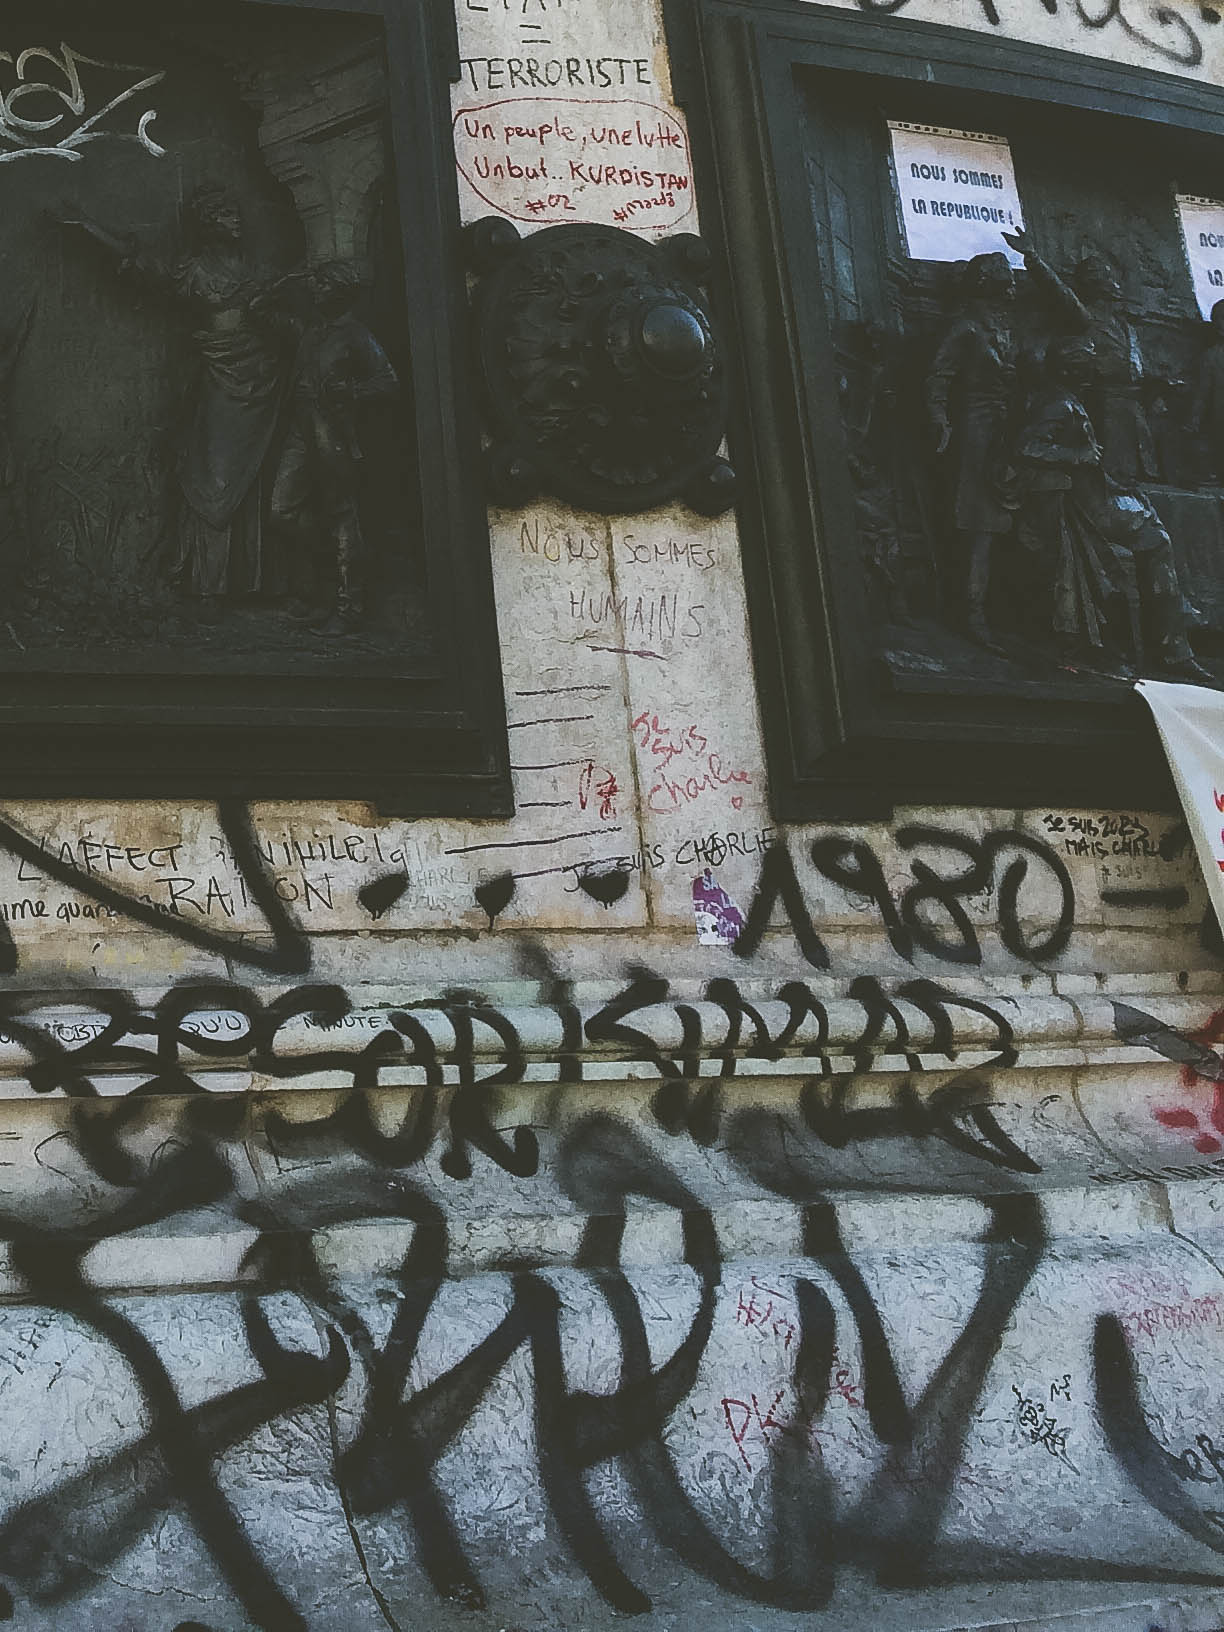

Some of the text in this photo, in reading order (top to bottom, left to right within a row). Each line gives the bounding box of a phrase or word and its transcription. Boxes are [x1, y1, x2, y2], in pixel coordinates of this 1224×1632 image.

[460, 58, 652, 91] TERRORISTE
[910, 162, 1004, 190] NOUS SOMMES
[911, 198, 928, 215] LA
[930, 200, 1006, 224] REPUBLIQUE
[520, 518, 716, 570] NOUS SOMMES
[569, 589, 706, 641] HUMAINS
